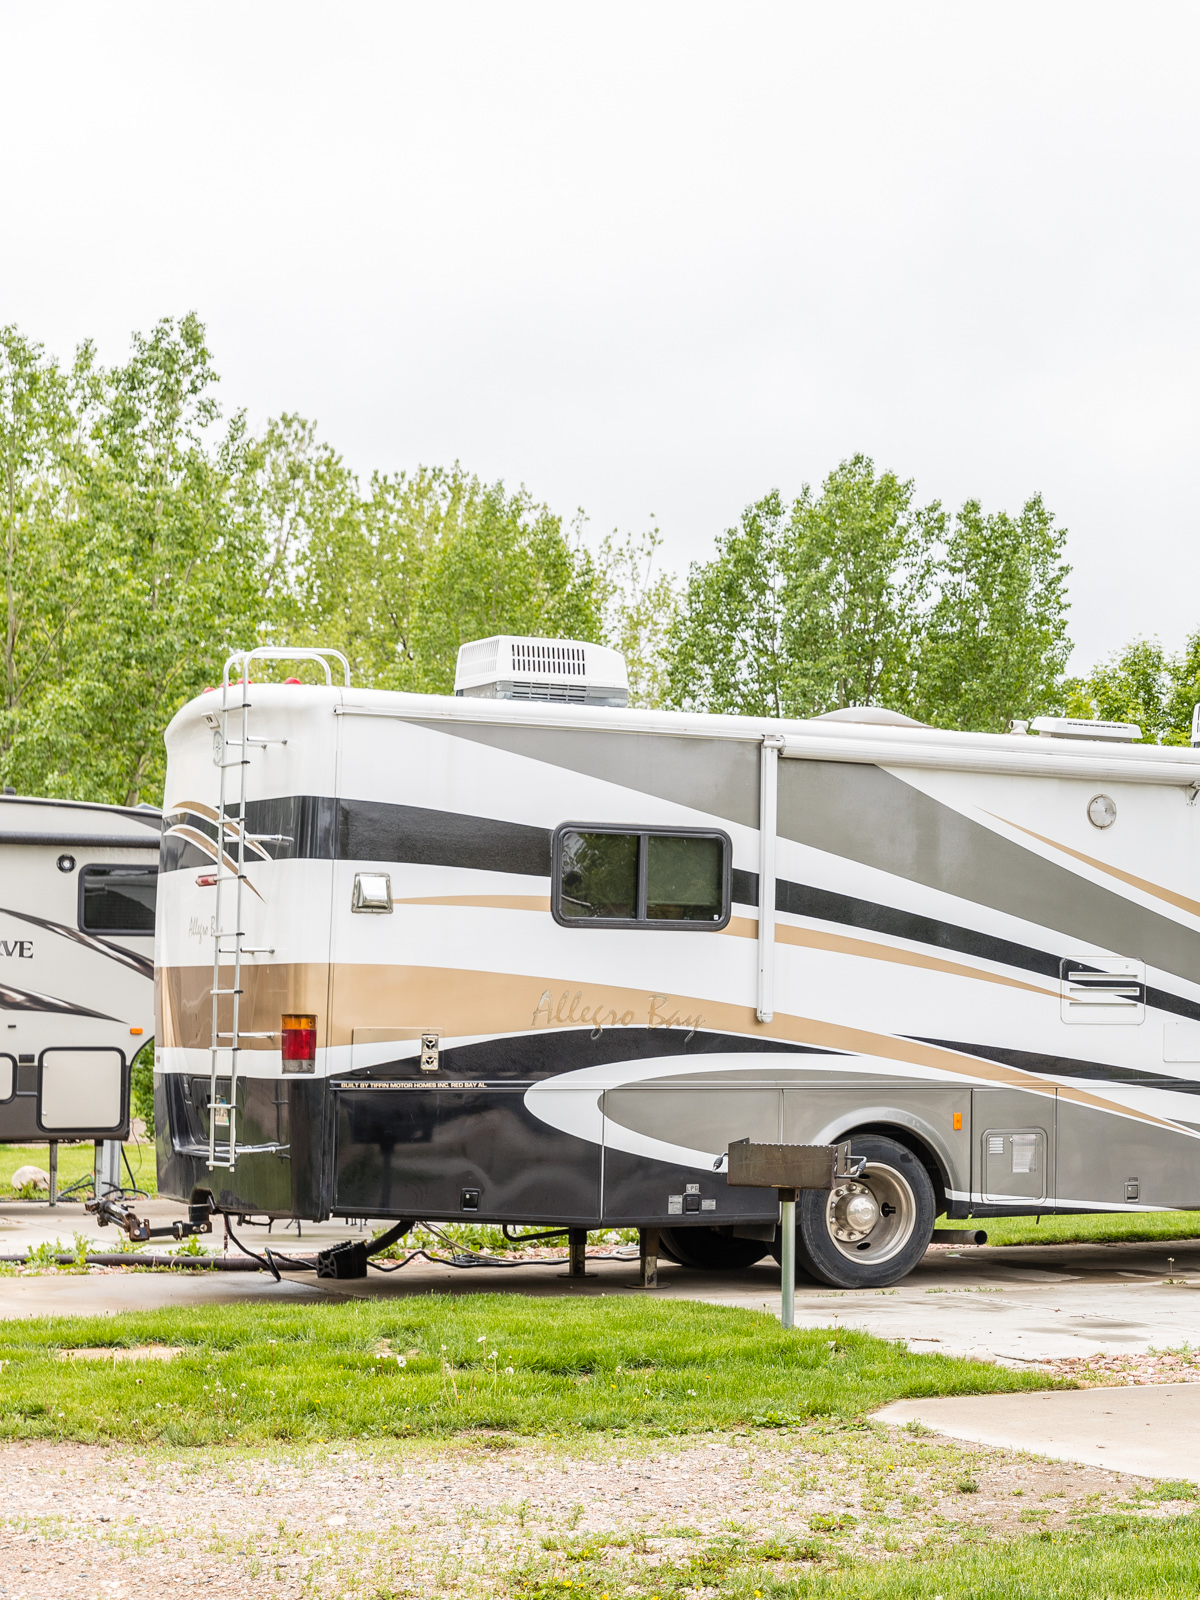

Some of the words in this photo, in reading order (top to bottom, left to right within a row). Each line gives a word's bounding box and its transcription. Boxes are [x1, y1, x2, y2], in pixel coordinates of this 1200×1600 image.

[0, 940, 34, 959] VE
[531, 989, 635, 1041] Allegro
[646, 994, 706, 1043] Bay
